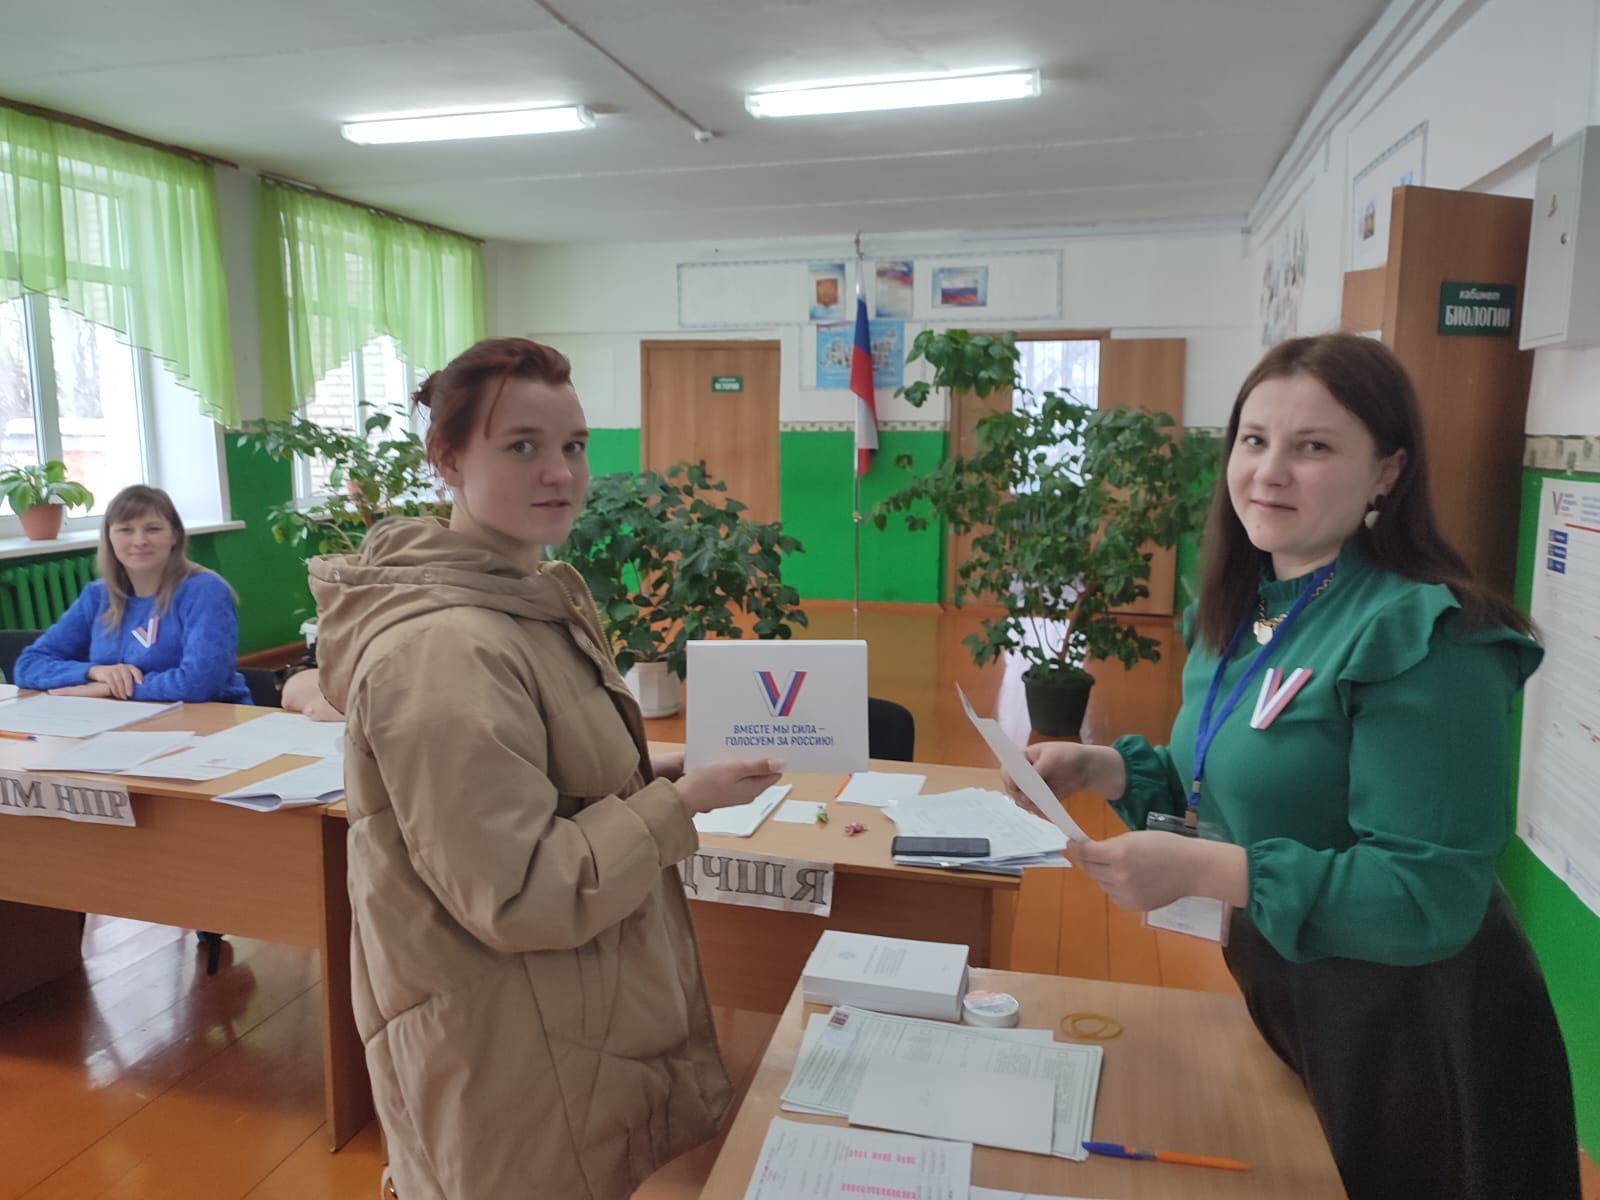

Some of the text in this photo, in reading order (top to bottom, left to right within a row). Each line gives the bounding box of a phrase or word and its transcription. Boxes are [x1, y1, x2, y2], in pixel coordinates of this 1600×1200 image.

[1445, 305, 1511, 327] БИОЛОГИИ
[733, 724, 770, 735] ВМЕСТЕ
[772, 724, 790, 735] МЫ
[725, 736, 833, 747] ГОЛОСУЕМ ЗА РОССИЮ!
